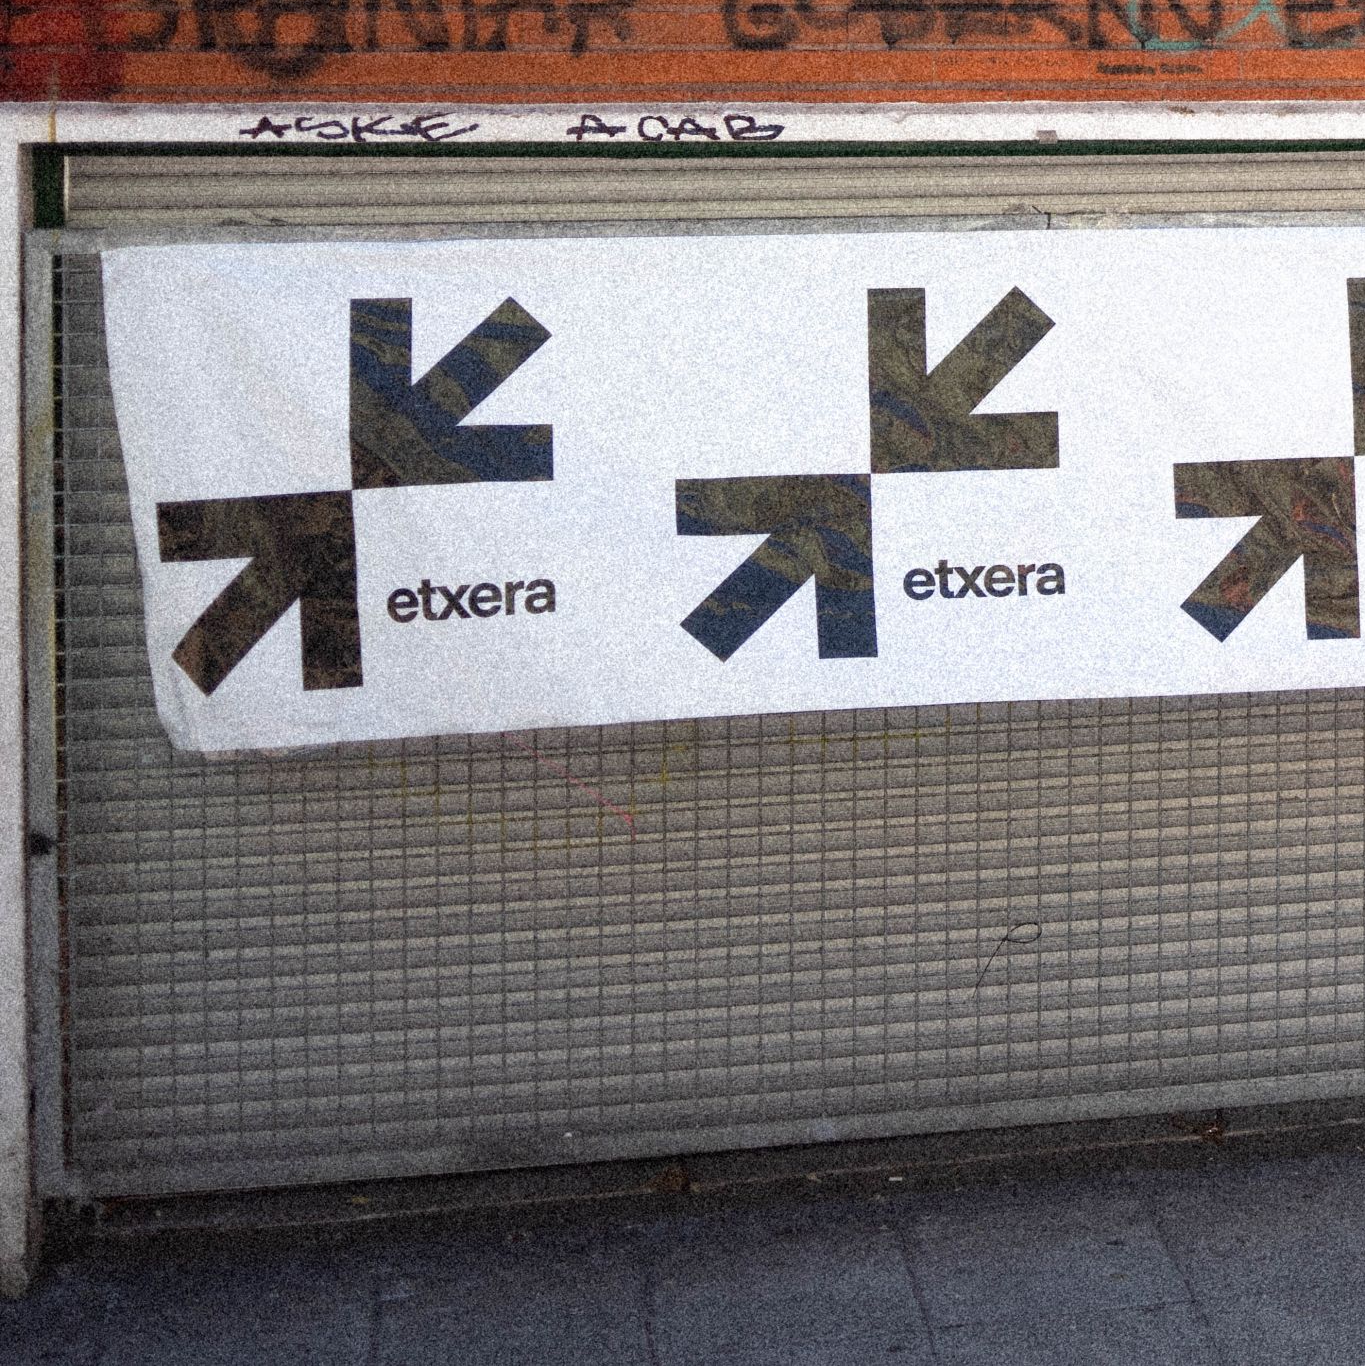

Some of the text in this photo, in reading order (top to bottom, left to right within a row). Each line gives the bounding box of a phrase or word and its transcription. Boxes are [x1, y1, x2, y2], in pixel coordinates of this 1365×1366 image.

[239, 112, 480, 142] ASKE
[567, 113, 786, 142] ACAB
[903, 559, 1066, 601] etxera
[386, 577, 557, 624] etxera
